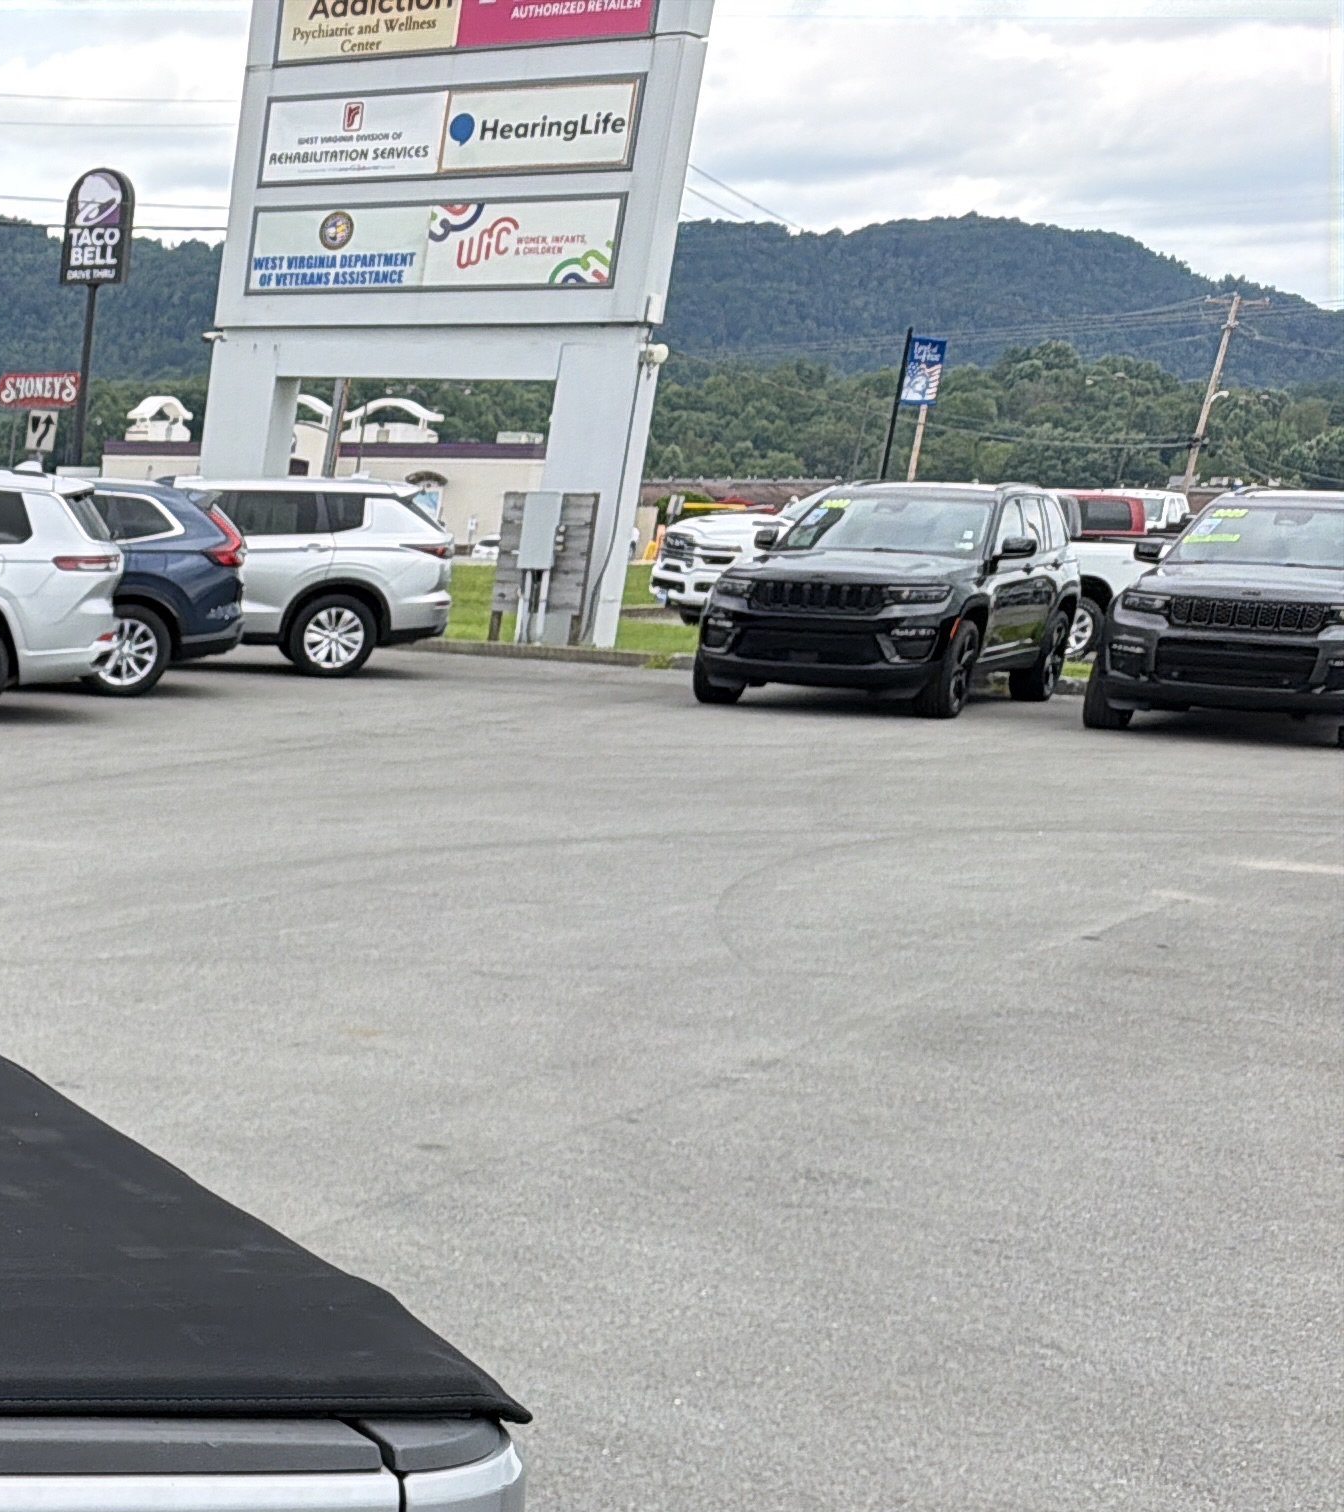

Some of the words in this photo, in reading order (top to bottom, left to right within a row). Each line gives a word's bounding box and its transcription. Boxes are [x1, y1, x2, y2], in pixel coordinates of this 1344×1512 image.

[511, 1, 585, 19] AUTHORIZED
[292, 22, 354, 45] Psychiatric
[357, 19, 380, 35] and
[384, 16, 437, 33] Wellness
[340, 39, 381, 53] Center
[479, 112, 625, 141] HearingLife
[298, 136, 318, 145] WEST
[356, 133, 389, 143] DIVISION
[391, 132, 402, 140] OF
[269, 148, 369, 165] REHABILITATION
[372, 145, 429, 161] SERVICES
[69, 228, 121, 246] TACO
[70, 246, 117, 266] BELL
[523, 246, 563, 255] CHILDREN
[254, 255, 283, 271] WEST
[287, 254, 337, 270] VIRGINIA
[339, 252, 416, 268] DEPARTMENT
[259, 272, 274, 287] OF
[275, 271, 331, 286] VETERANS
[332, 269, 404, 285] ASSISTANCE
